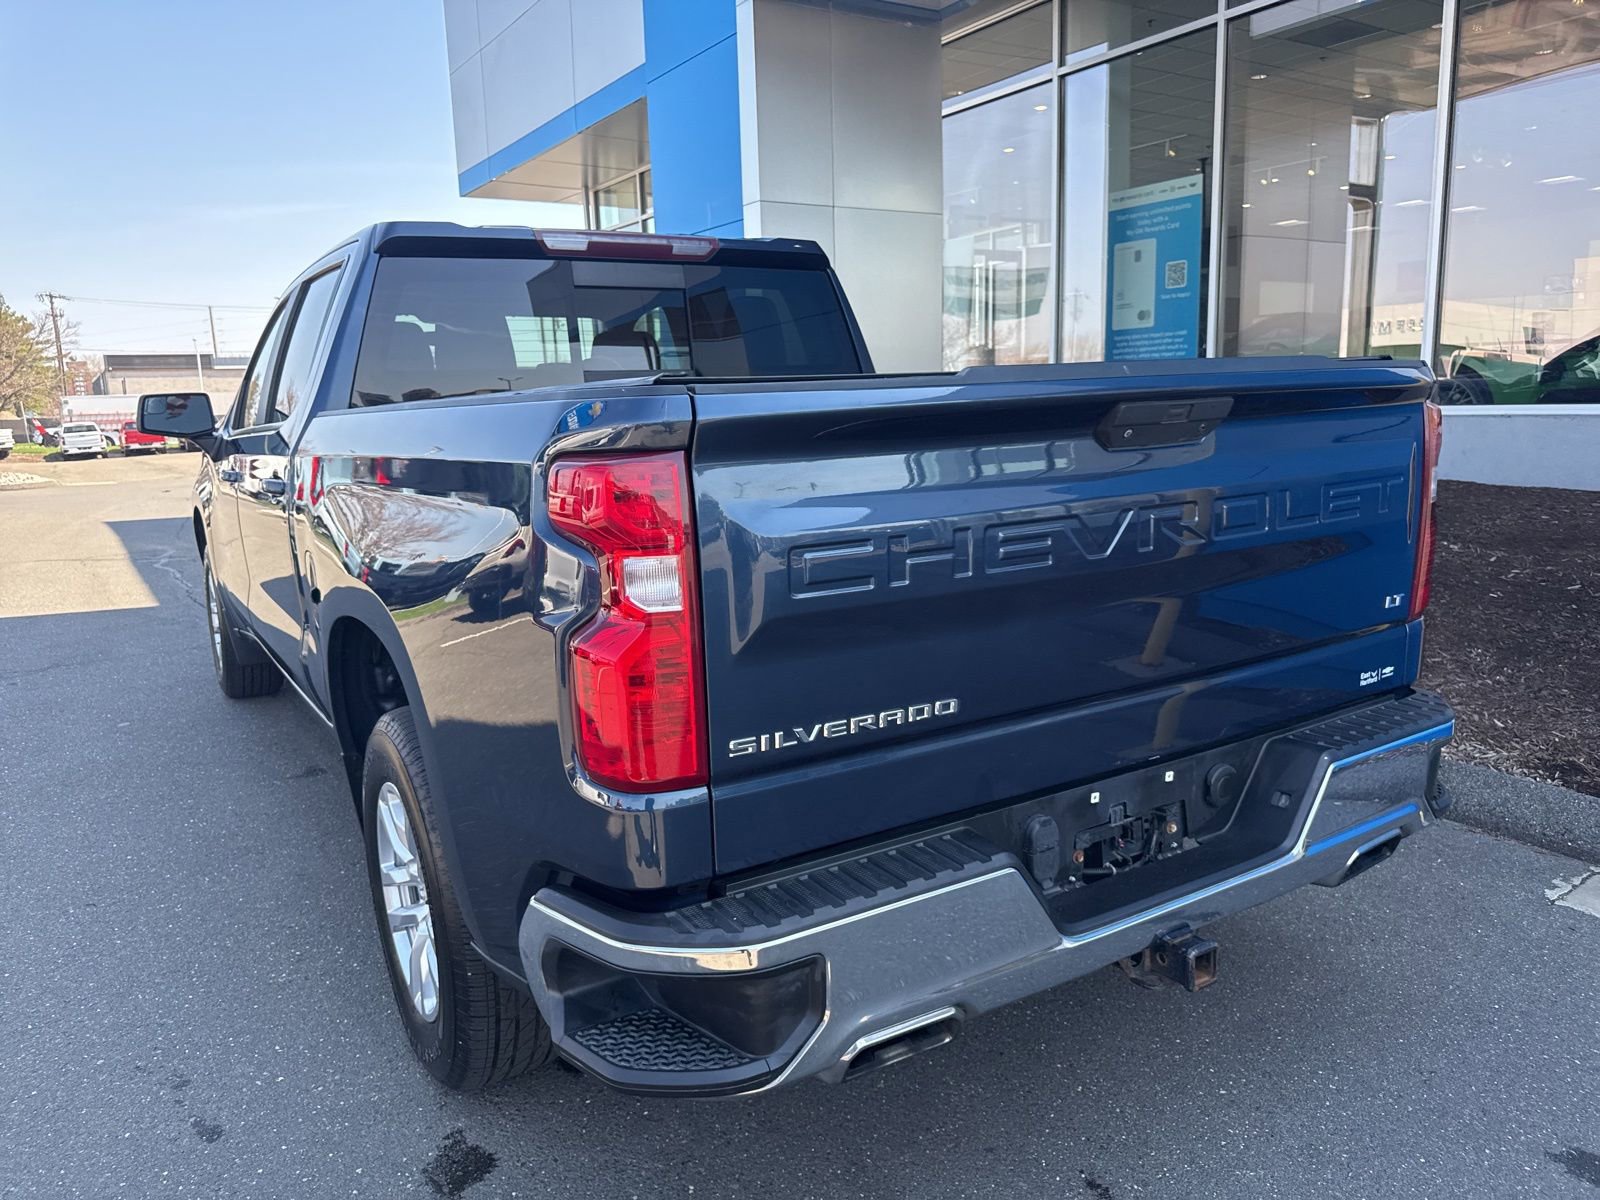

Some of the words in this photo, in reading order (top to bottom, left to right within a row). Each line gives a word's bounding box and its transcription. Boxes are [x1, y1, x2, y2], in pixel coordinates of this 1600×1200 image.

[788, 477, 1404, 600] CHEVROLET
[1385, 593, 1405, 609] LT
[728, 698, 959, 758] SILVERADO
